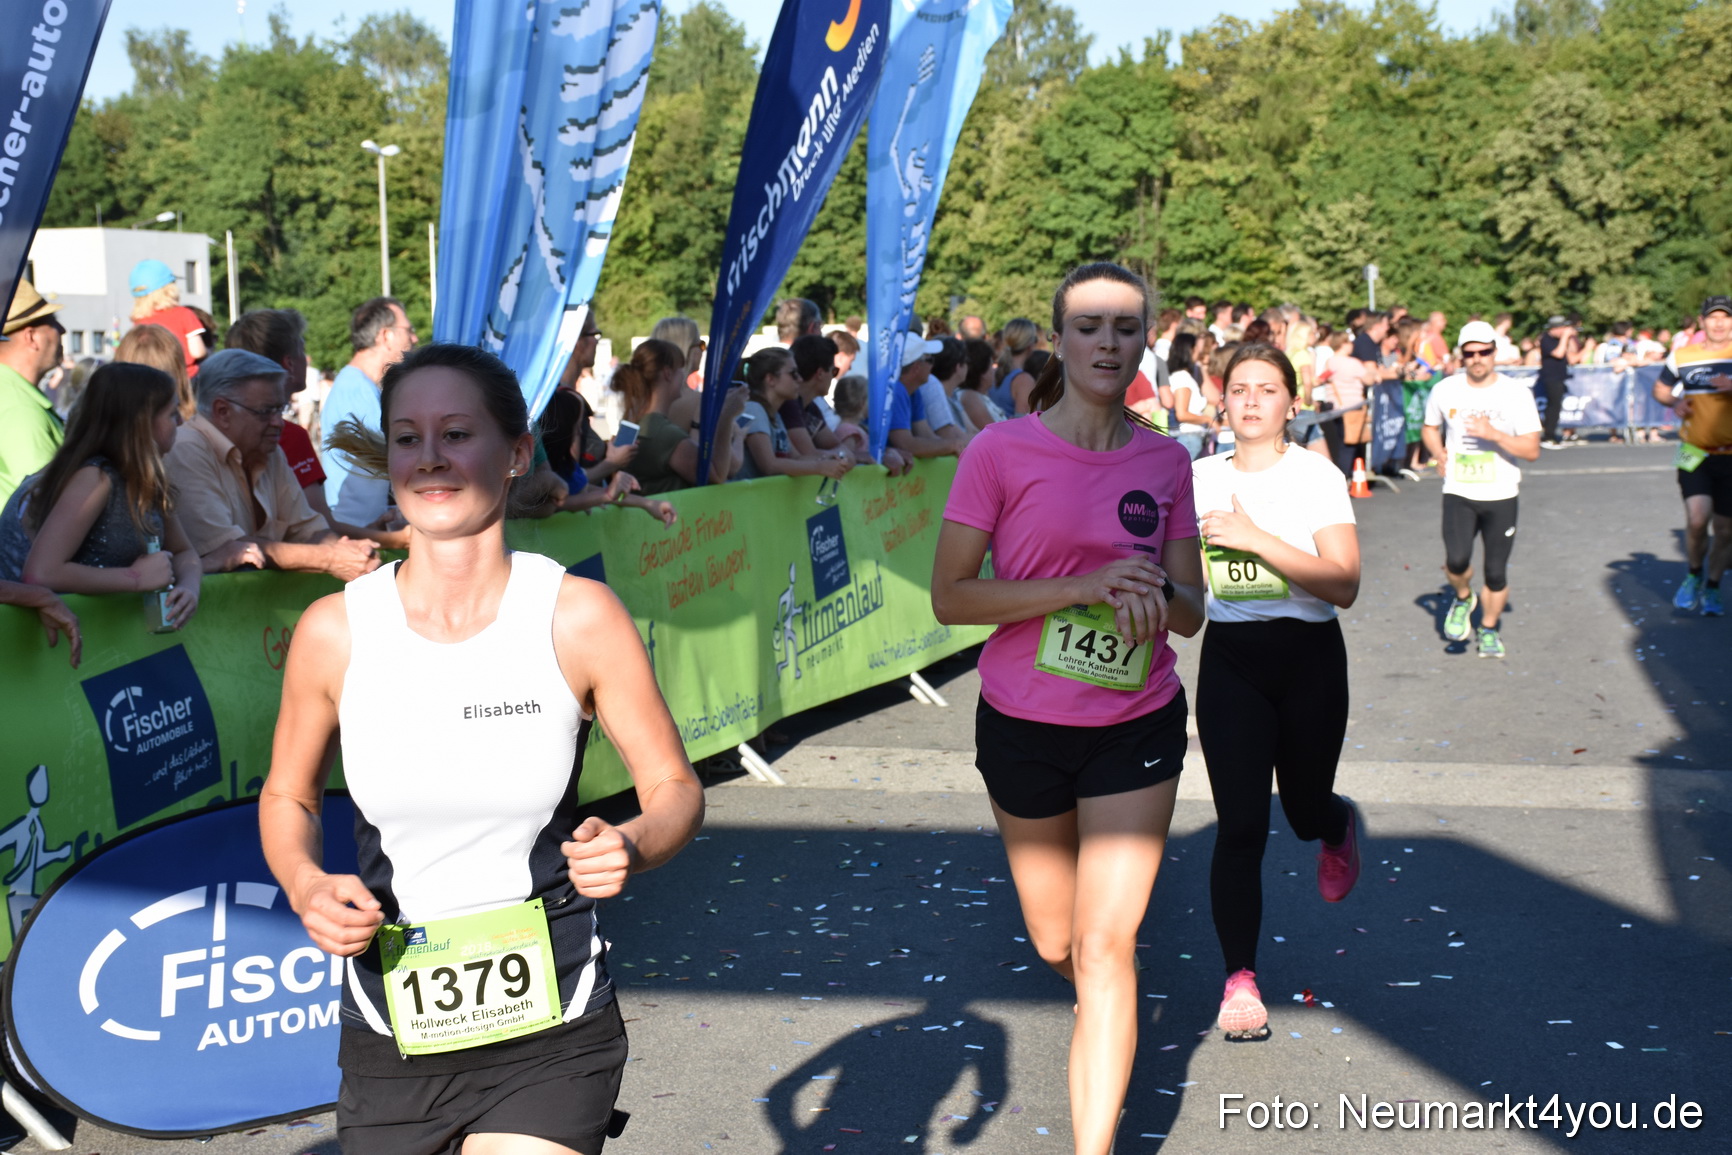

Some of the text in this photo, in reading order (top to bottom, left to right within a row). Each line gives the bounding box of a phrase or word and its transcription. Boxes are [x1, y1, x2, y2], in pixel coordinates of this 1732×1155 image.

[792, 138, 825, 202] Druck
[842, 23, 880, 102] Medien
[1228, 559, 1258, 583] 60
[802, 560, 883, 651] firmenlauf
[1057, 623, 1139, 667] 1437
[1058, 653, 1087, 667] Lehrer
[1088, 660, 1129, 676] Katharina
[1065, 663, 1076, 671] NM
[1090, 669, 1118, 681] Apotheke
[122, 695, 193, 743] Fischer
[463, 699, 541, 720] Elisabeth
[136, 720, 194, 755] AUTOMOBILE
[402, 952, 531, 1016] 1379
[197, 1000, 340, 1051] AUTOM
[410, 1013, 468, 1031] Hollweck
[472, 999, 534, 1022] Elisabeth
[420, 1021, 495, 1040] M-motion-design
[497, 1013, 526, 1027] GmbH
